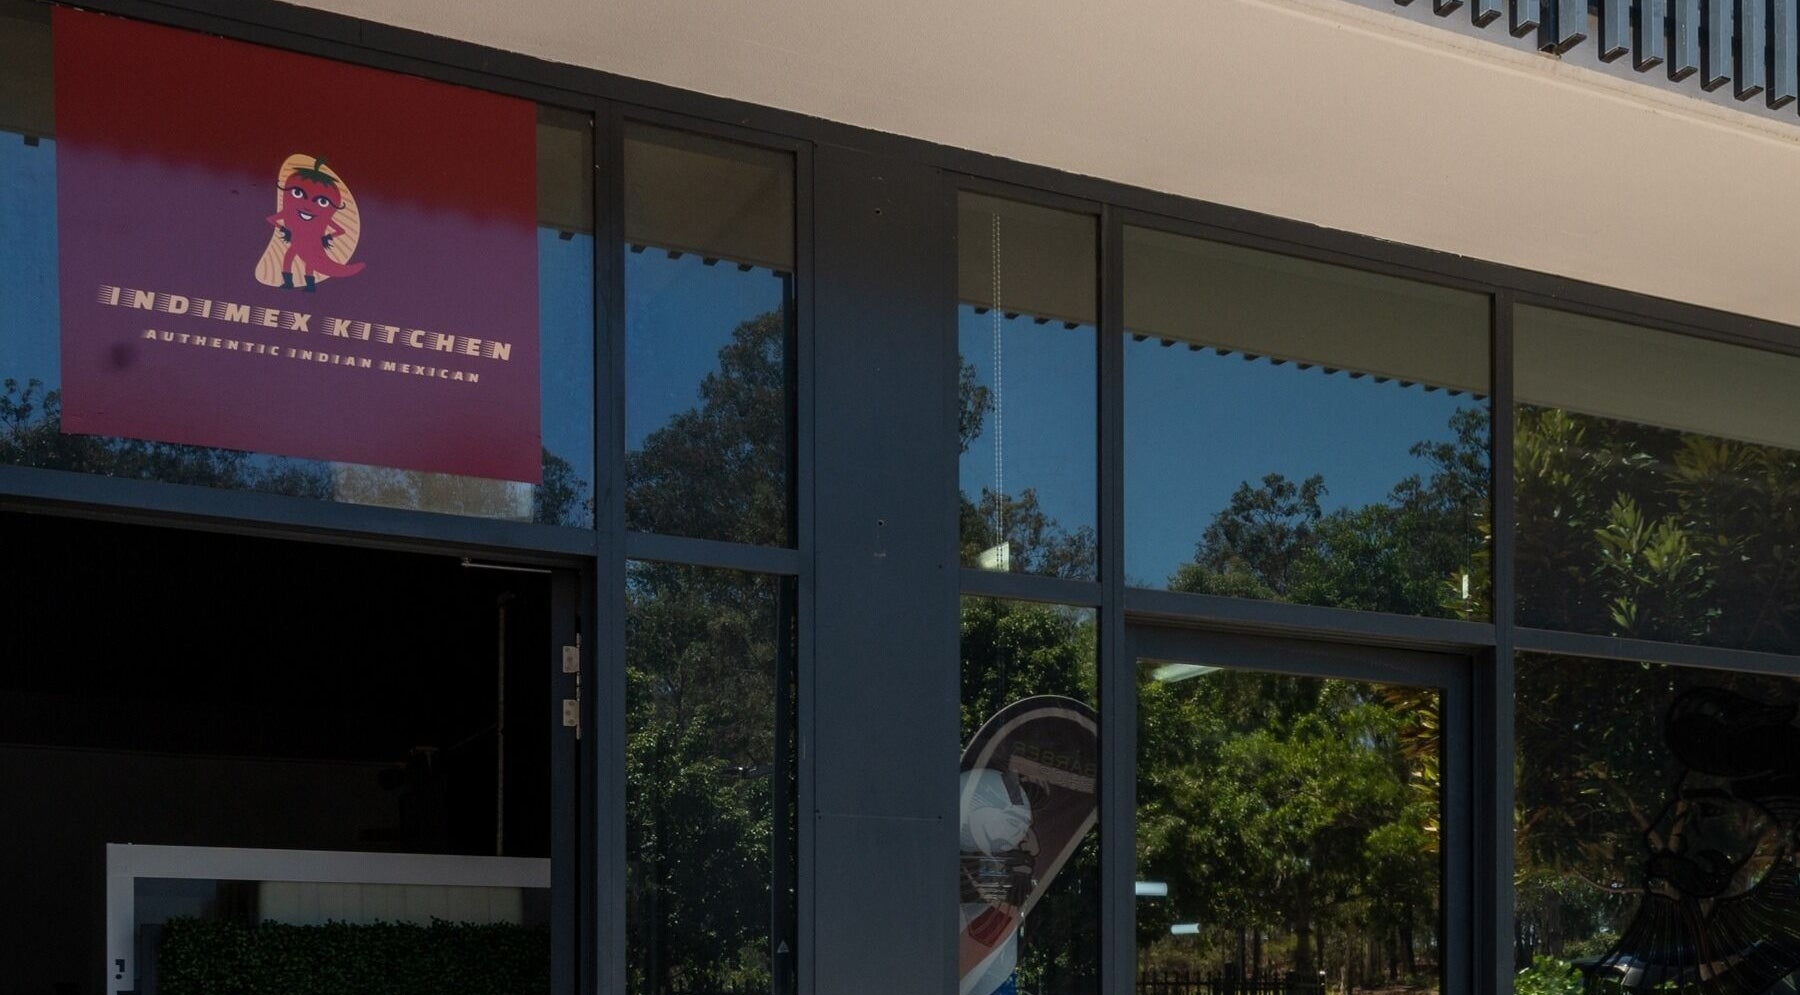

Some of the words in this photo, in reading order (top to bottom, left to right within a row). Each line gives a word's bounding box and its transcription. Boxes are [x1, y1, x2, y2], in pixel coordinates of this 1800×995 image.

[99, 284, 313, 333] INDIMEX
[321, 315, 512, 361] KITCHEN
[142, 328, 279, 356] AUTHENTIC
[287, 347, 373, 368] INDIAN
[380, 360, 480, 383] MEXICAN
